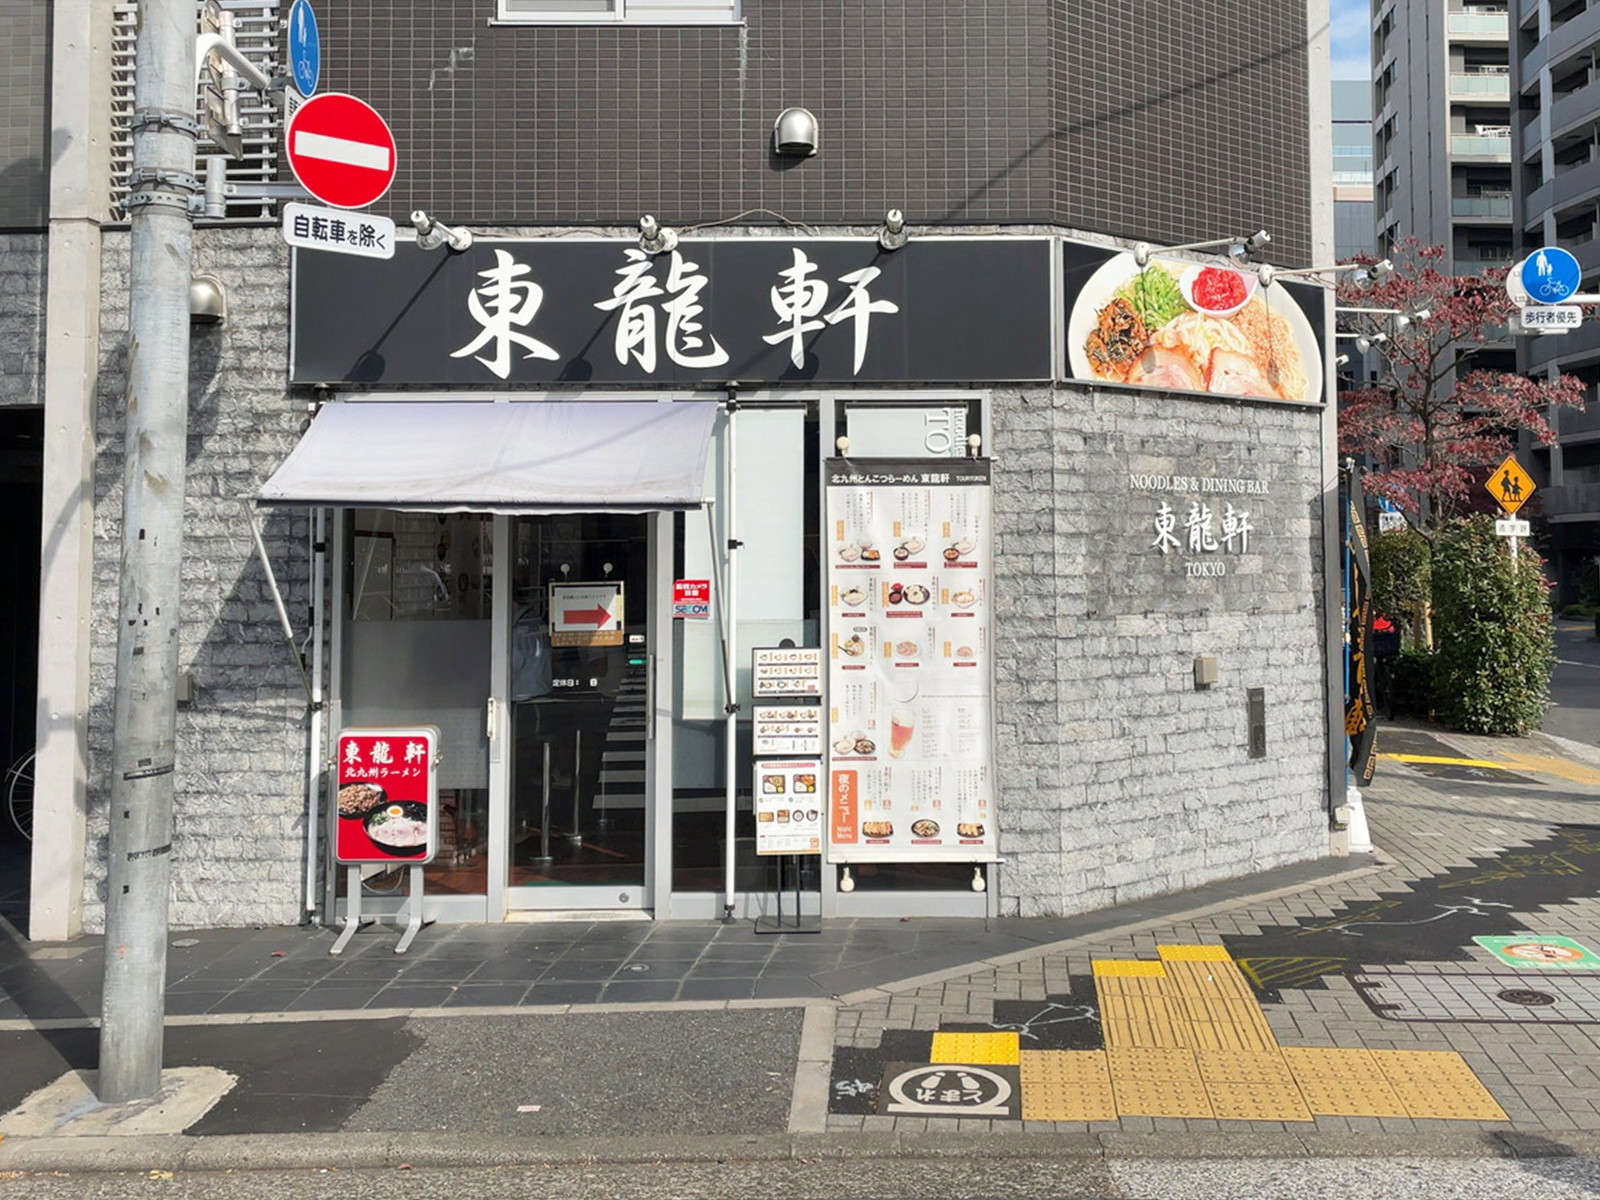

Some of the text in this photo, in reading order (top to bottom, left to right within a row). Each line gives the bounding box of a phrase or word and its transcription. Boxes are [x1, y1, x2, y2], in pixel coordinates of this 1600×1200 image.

[294, 214, 386, 250] 自転車を除く
[449, 247, 899, 380] 東龍軒
[1525, 311, 1577, 324] 歩行者優先
[831, 474, 918, 483] 北九州とんこつらーめん
[1130, 474, 1270, 494] NOODLES & DINING BAR
[1151, 501, 1254, 554] 東龍軒
[1185, 562, 1226, 577] TOKYO
[342, 740, 426, 764] 東龍軒
[344, 767, 422, 779] 北九州ラーメン
[837, 773, 851, 823] 夜のメニュー
[915, 1088, 983, 1104] とまれ
